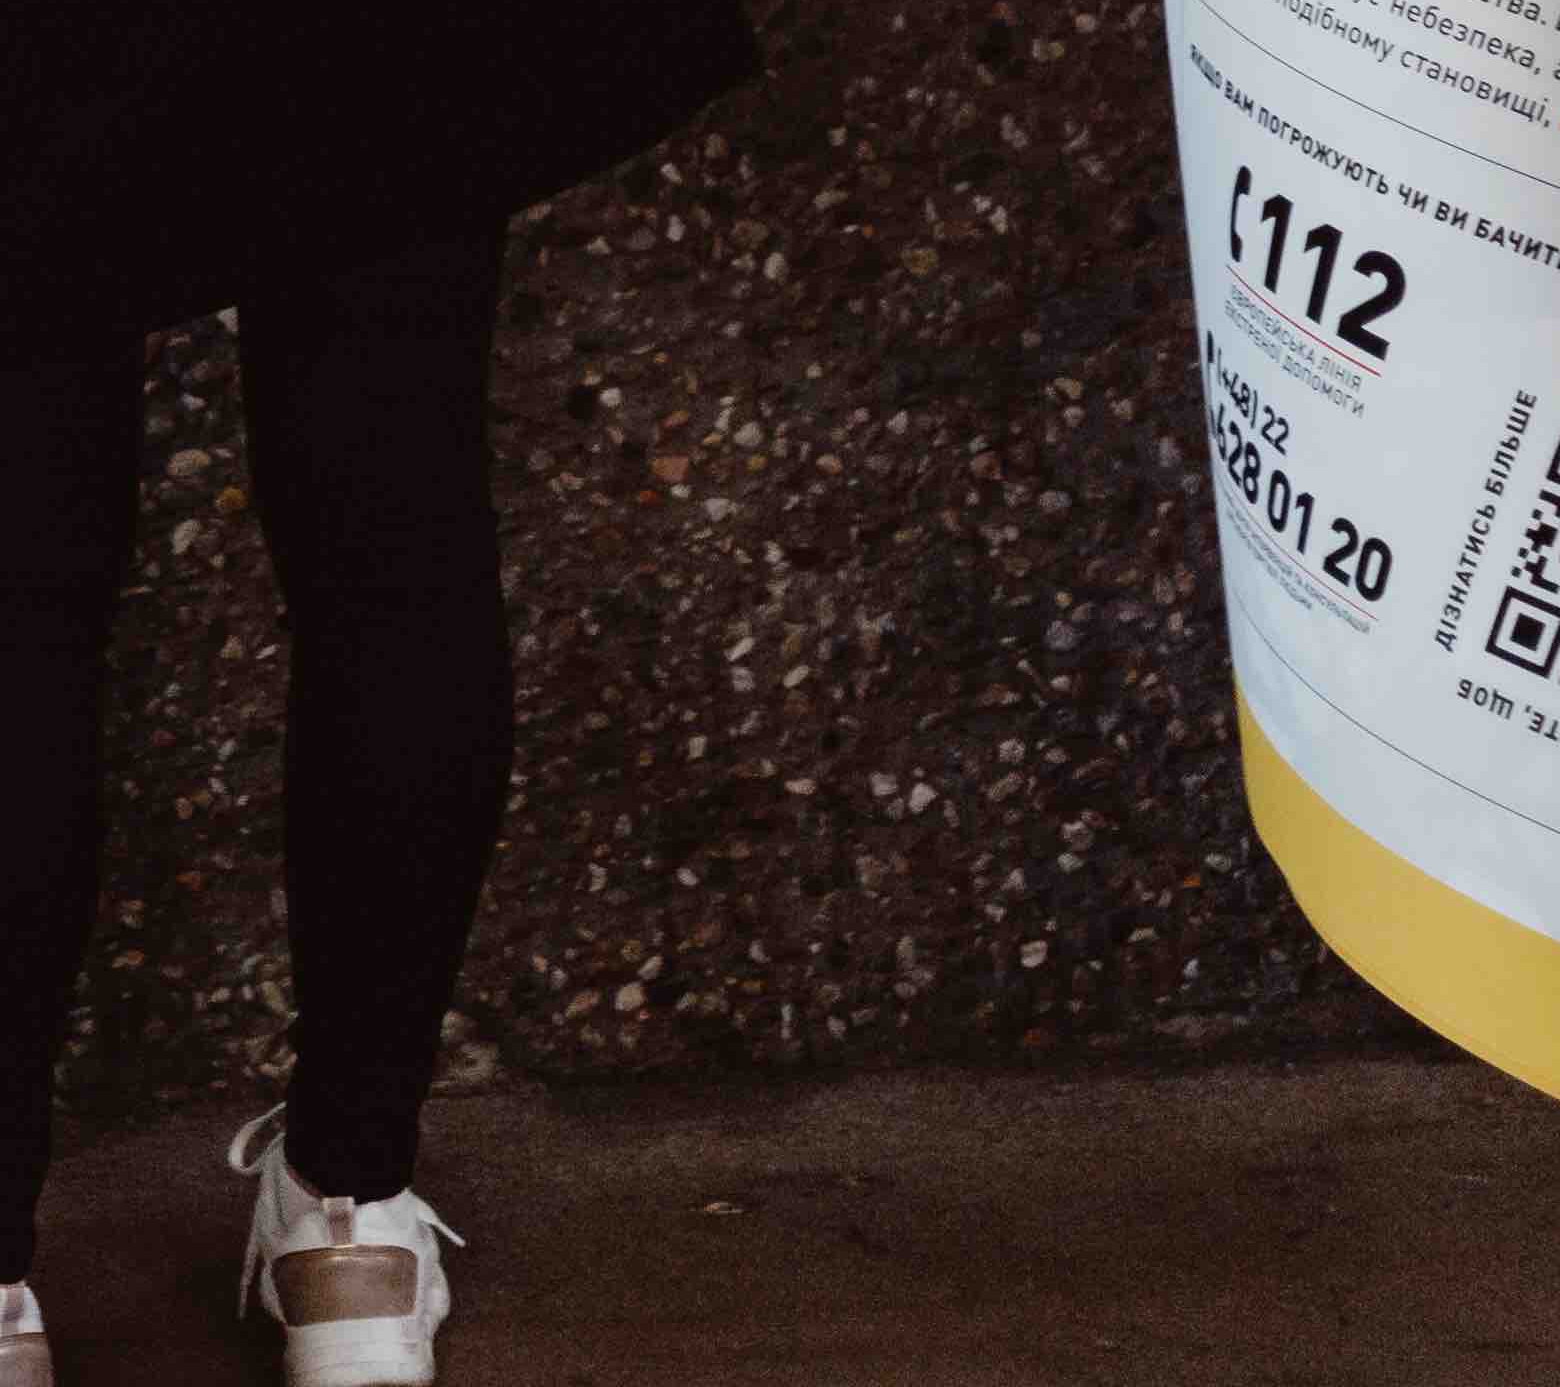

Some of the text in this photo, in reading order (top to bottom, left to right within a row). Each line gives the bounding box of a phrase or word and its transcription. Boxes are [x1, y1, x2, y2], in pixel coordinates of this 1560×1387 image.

[1258, 106, 1390, 196] ПОГРОЖУЮТЬ
[1397, 182, 1429, 214] ЧИ
[1434, 200, 1469, 231] ВИ
[1260, 194, 1406, 361] 112
[1261, 404, 1290, 456] 22
[1268, 469, 1315, 555] 01
[1323, 517, 1393, 602] 20
[1434, 388, 1538, 653] ДІЗНАТИСЬ БІЛЬШЕ
[1457, 677, 1515, 720] ЩОБ
